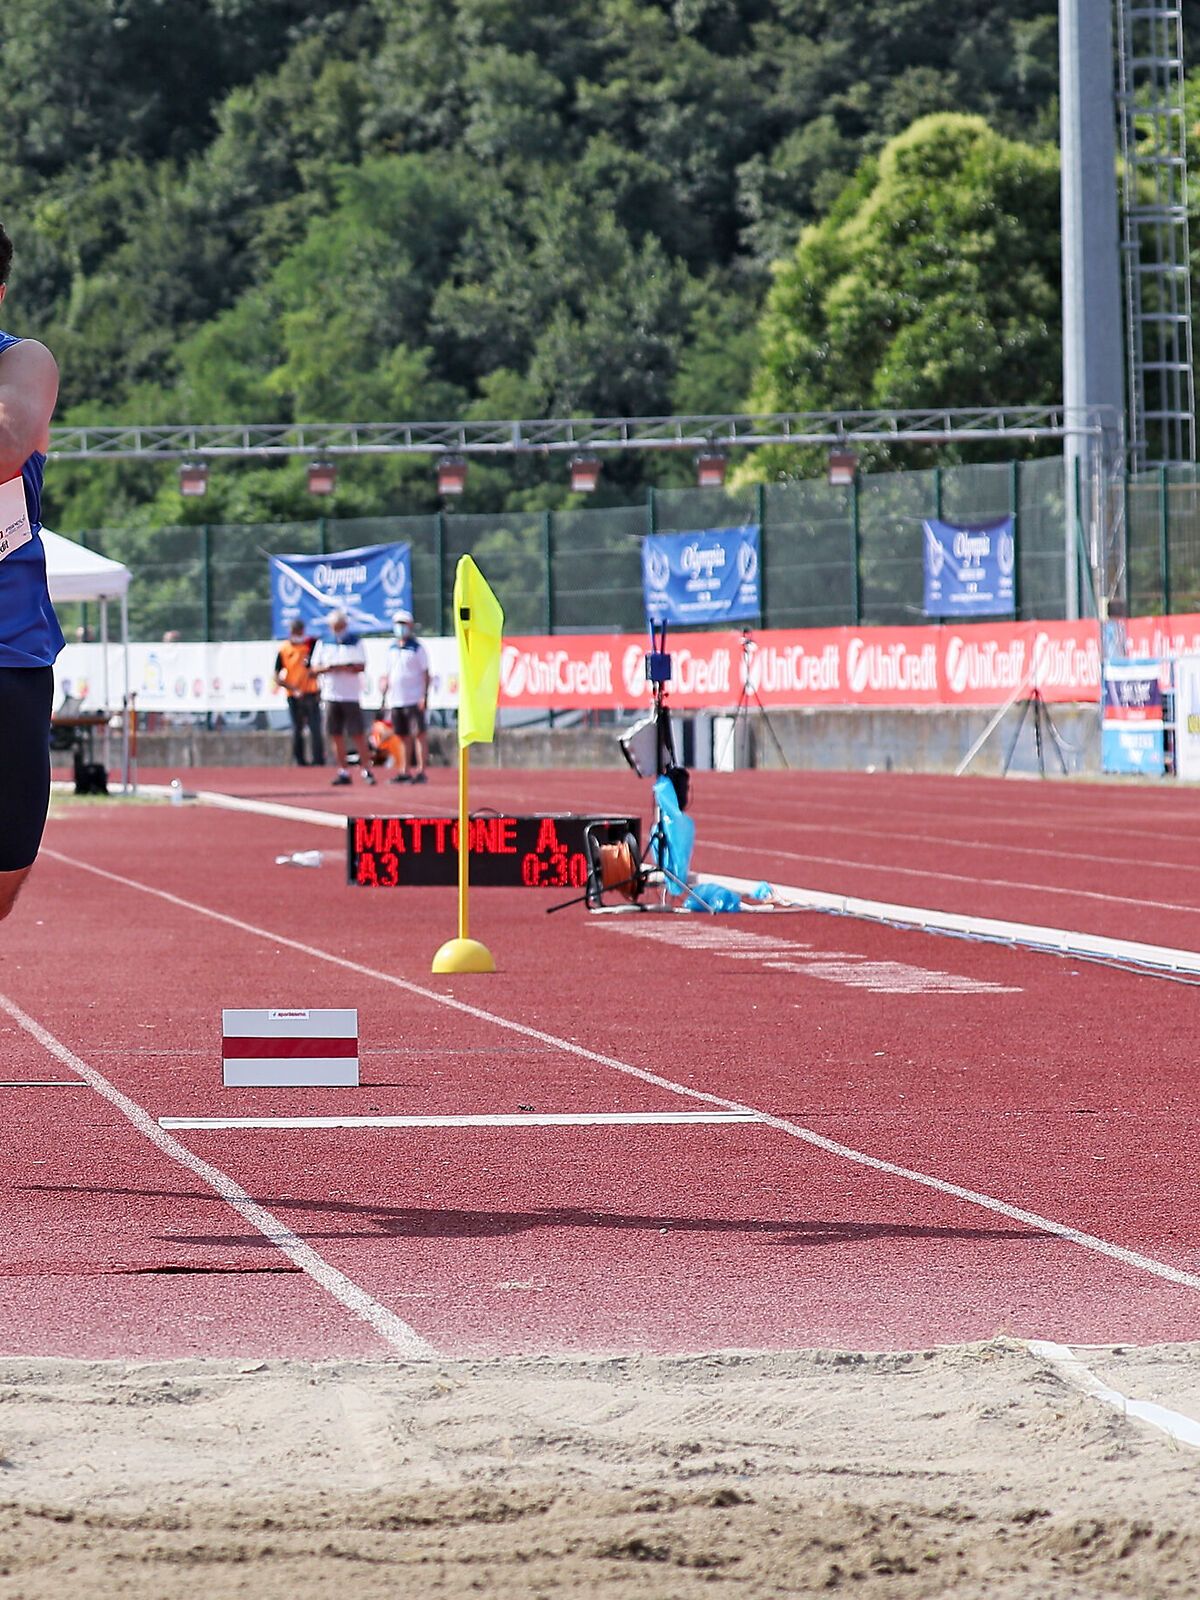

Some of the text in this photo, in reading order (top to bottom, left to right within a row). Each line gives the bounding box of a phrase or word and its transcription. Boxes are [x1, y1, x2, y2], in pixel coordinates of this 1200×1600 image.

[314, 562, 367, 594] Olympia
[681, 543, 725, 579] Olympia
[527, 651, 613, 694] UniCredit
[762, 645, 840, 691] UniCredit
[870, 643, 938, 691] UniCredit
[967, 640, 1025, 689] UniCredit
[355, 818, 568, 853] MATTONE A.
[356, 853, 587, 888] A3 0:30
